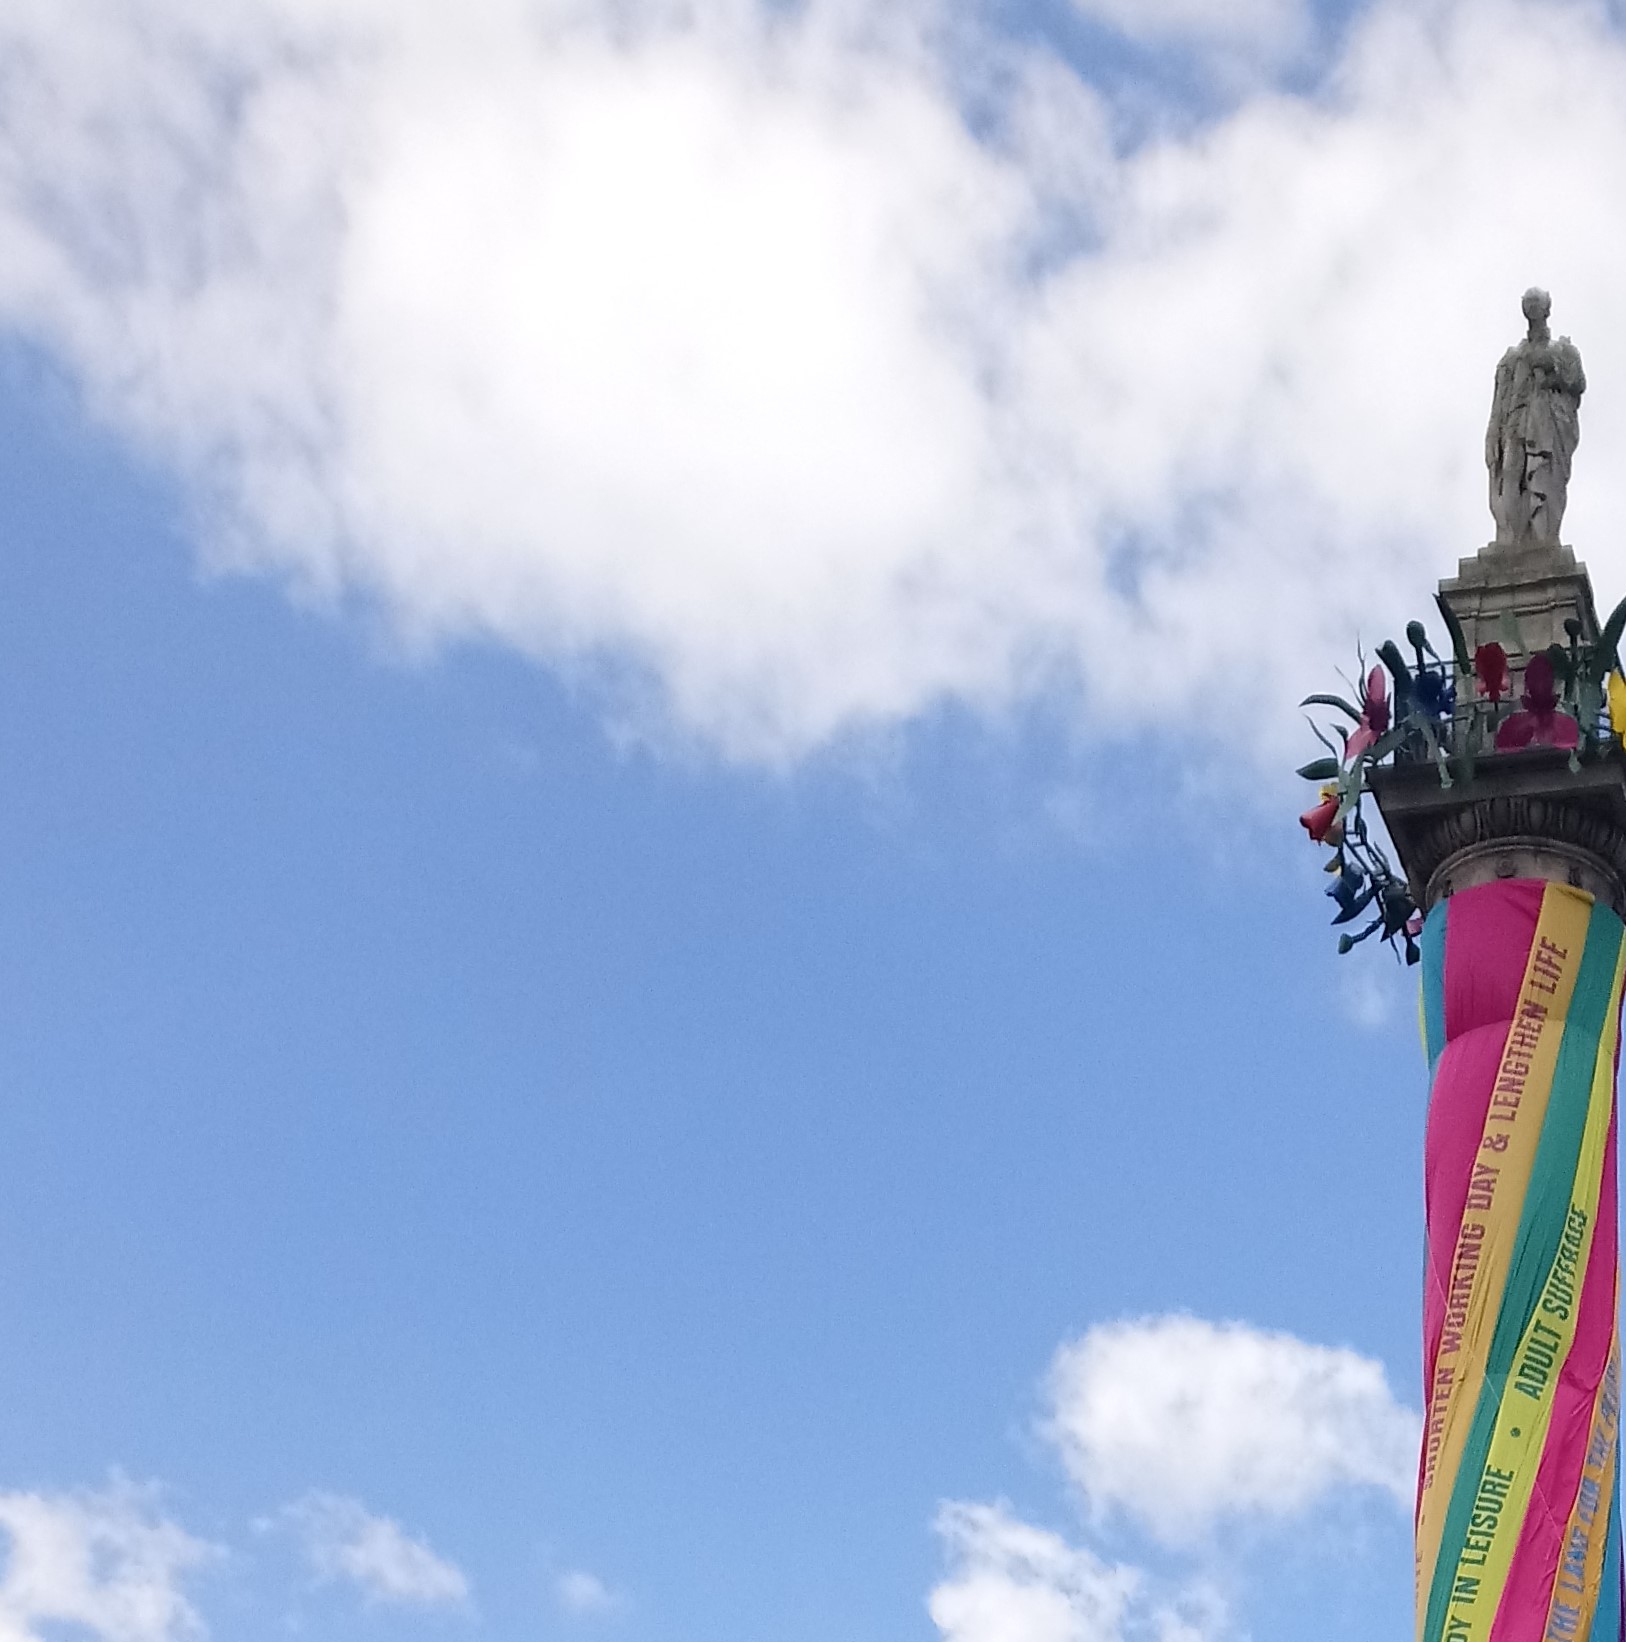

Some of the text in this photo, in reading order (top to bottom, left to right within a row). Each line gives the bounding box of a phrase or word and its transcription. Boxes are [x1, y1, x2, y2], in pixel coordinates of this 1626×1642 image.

[1530, 935, 1569, 999] LIFE
[1489, 998, 1548, 1124] LENGTHEN
[1482, 1125, 1510, 1154] &
[1466, 1161, 1502, 1212] DAY
[1440, 1222, 1486, 1355] WORKING
[1514, 1320, 1563, 1401] ADULT
[1460, 1465, 1515, 1567] LEISURE
[1452, 1576, 1481, 1605] IN
